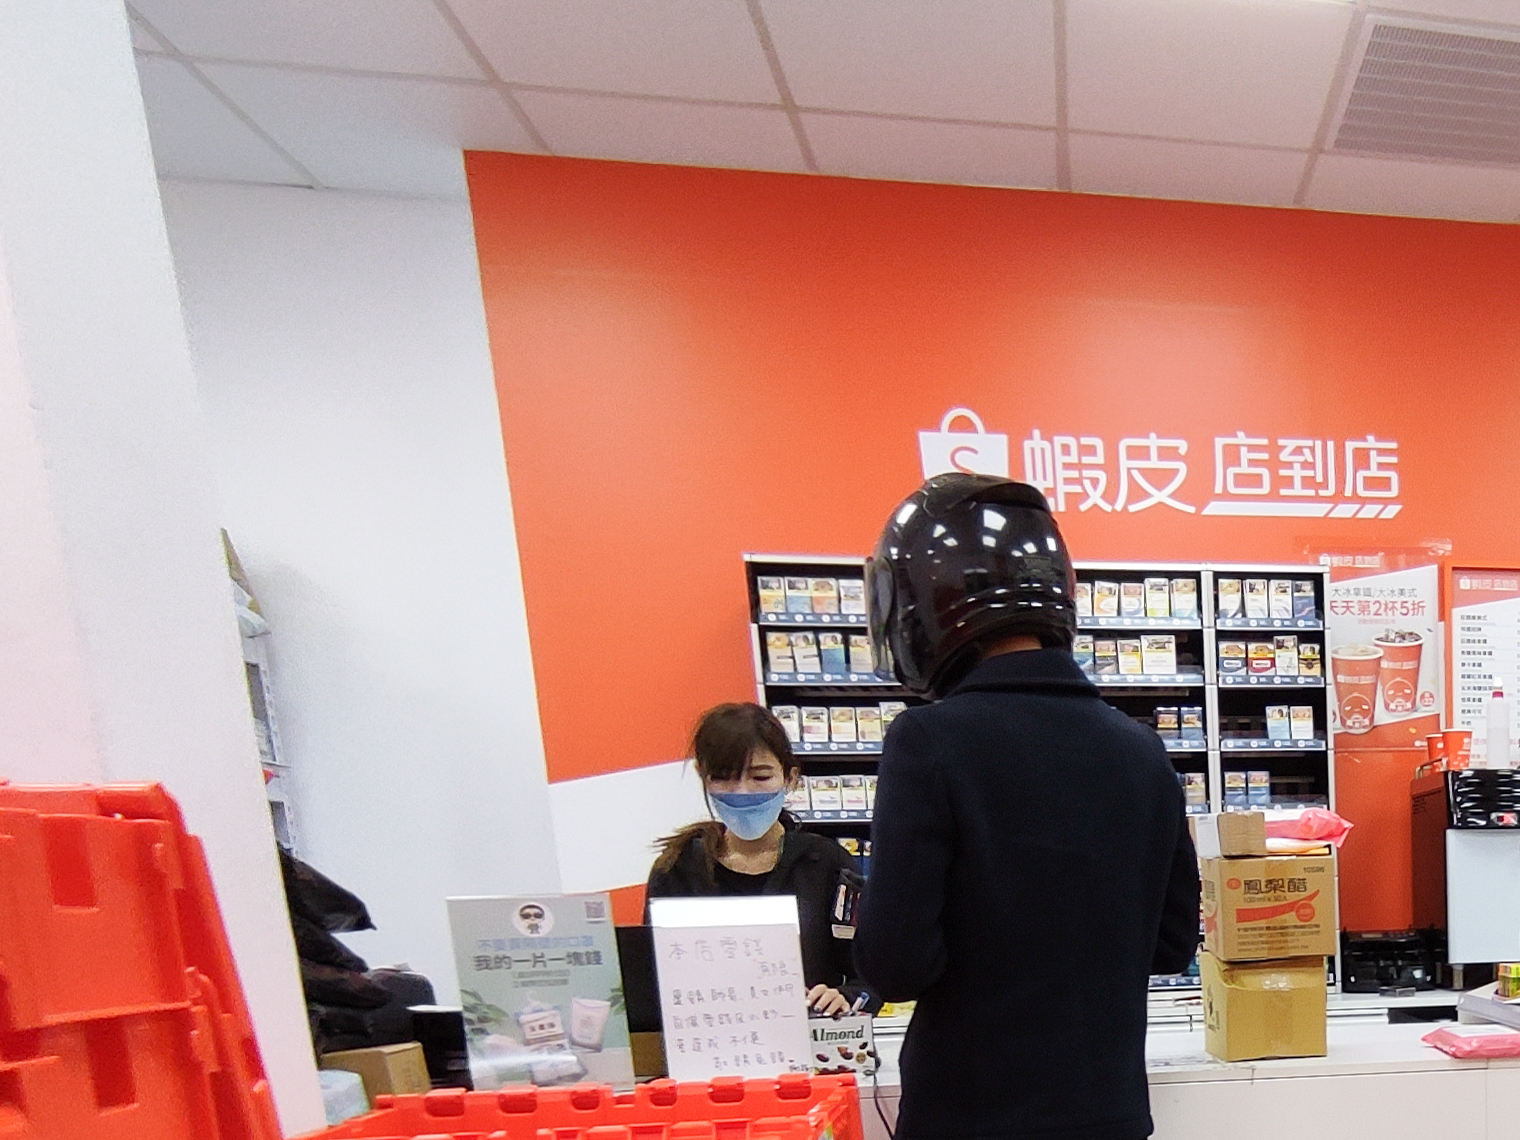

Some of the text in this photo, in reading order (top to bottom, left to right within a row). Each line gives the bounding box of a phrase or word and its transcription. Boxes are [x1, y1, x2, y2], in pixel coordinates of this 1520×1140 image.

[1023, 429, 1197, 514] 蝦皮
[1213, 430, 1400, 499] 店到店
[474, 950, 604, 971] 我的一片一塊錢
